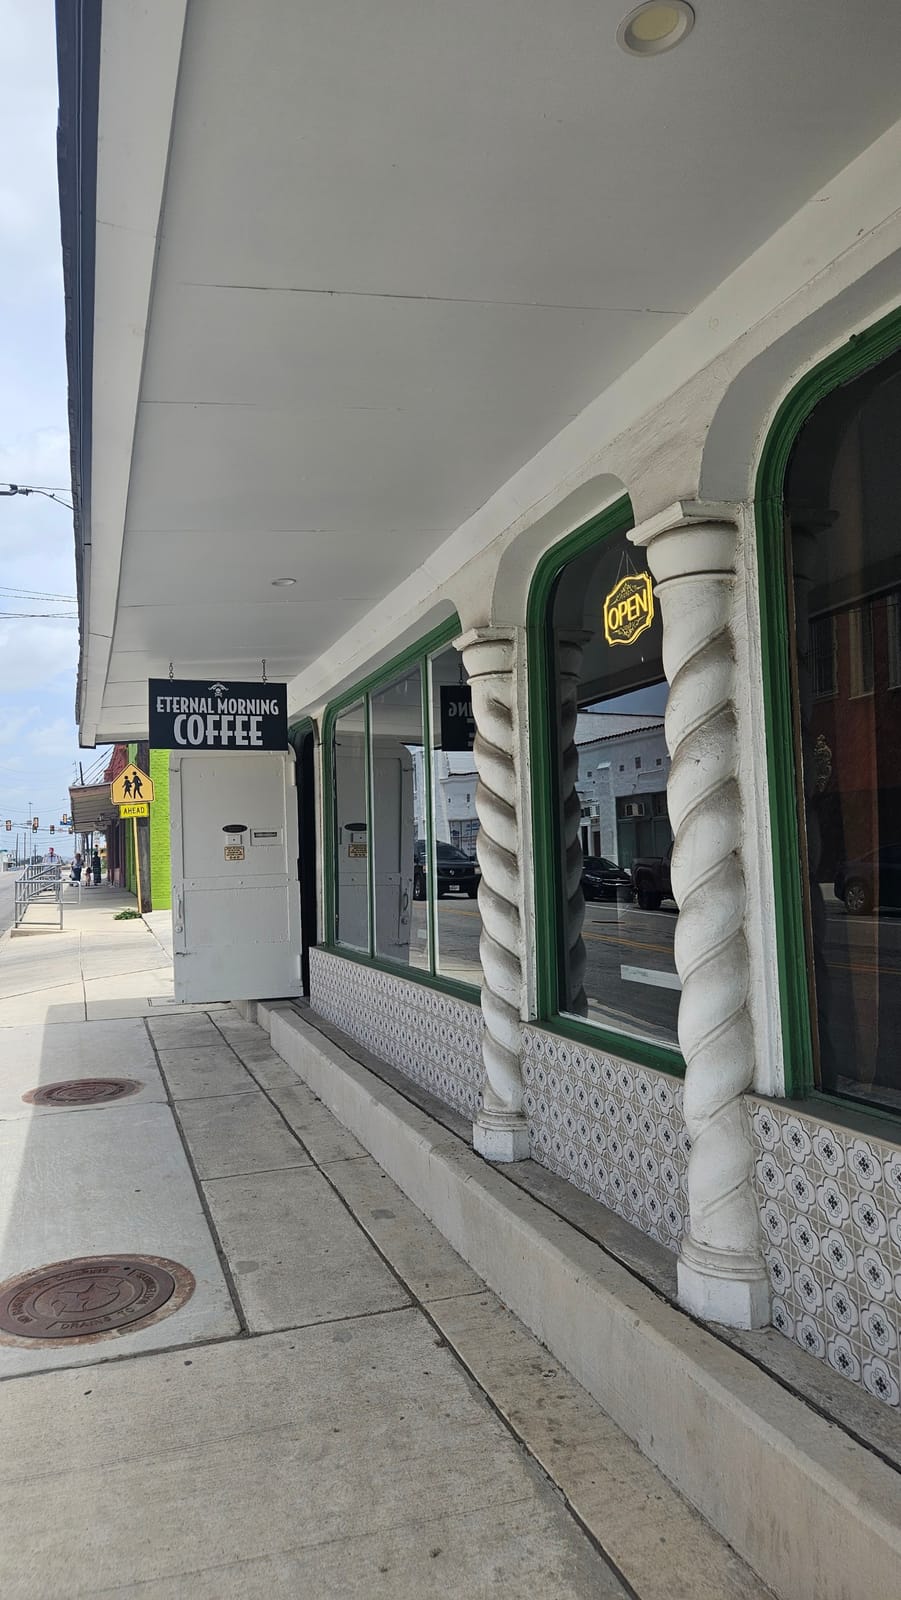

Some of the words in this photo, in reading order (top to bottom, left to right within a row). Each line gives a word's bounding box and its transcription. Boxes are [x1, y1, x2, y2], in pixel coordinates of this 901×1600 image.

[608, 588, 648, 630] OPEN
[156, 696, 215, 714] ETERNAL
[217, 698, 279, 716] MORNING
[173, 714, 264, 746] COFFEE
[123, 806, 145, 815] AHEAD
[60, 1316, 112, 1330] DRAINS
[117, 1306, 135, 1317] TO
